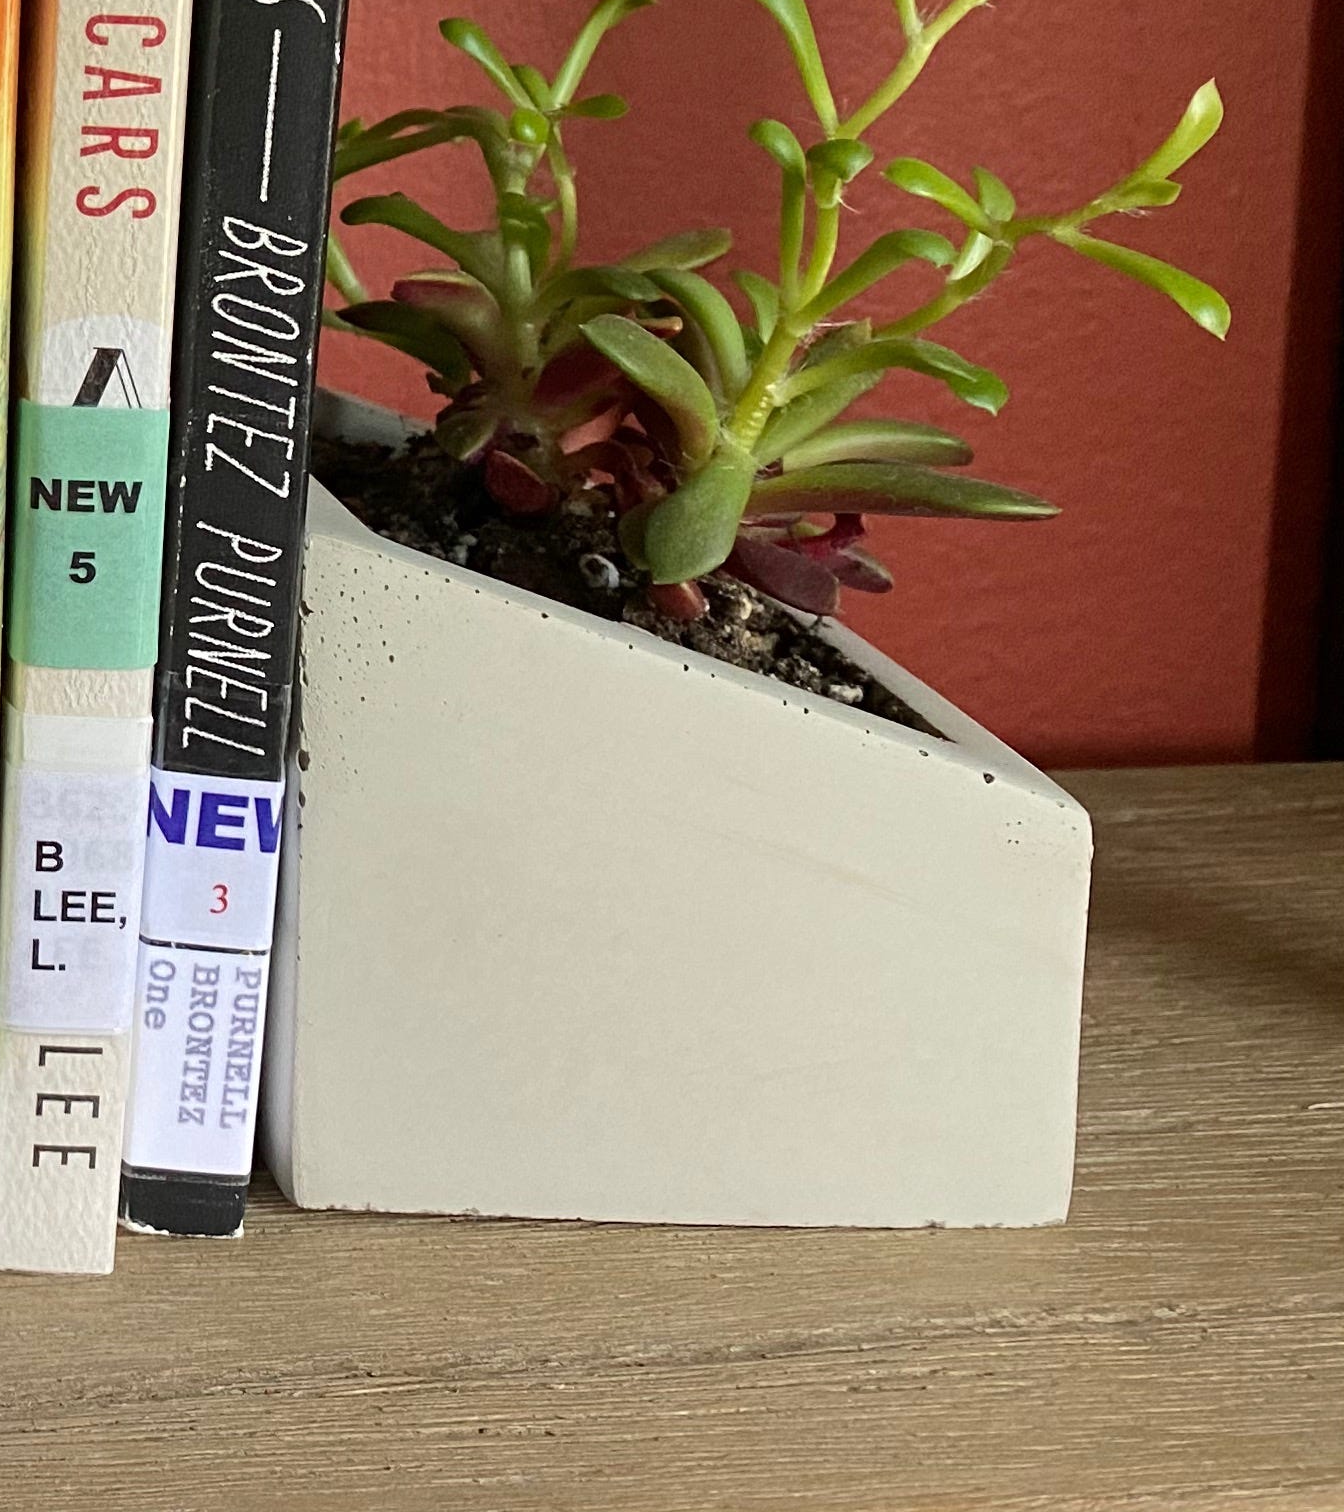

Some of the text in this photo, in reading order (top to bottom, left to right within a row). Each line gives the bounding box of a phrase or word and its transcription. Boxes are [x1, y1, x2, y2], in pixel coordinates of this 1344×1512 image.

[205, 215, 309, 499] BRONTEZ
[29, 477, 143, 514] NEW
[68, 551, 97, 585] 5
[182, 520, 283, 757] PURNELL
[35, 840, 64, 873] B
[32, 889, 128, 931] LEE,
[209, 884, 230, 915] 3
[30, 939, 67, 971] L.
[177, 963, 220, 1127] BRONTEZ
[220, 966, 262, 1130] PURNELL
[31, 1045, 104, 1169] LEE
